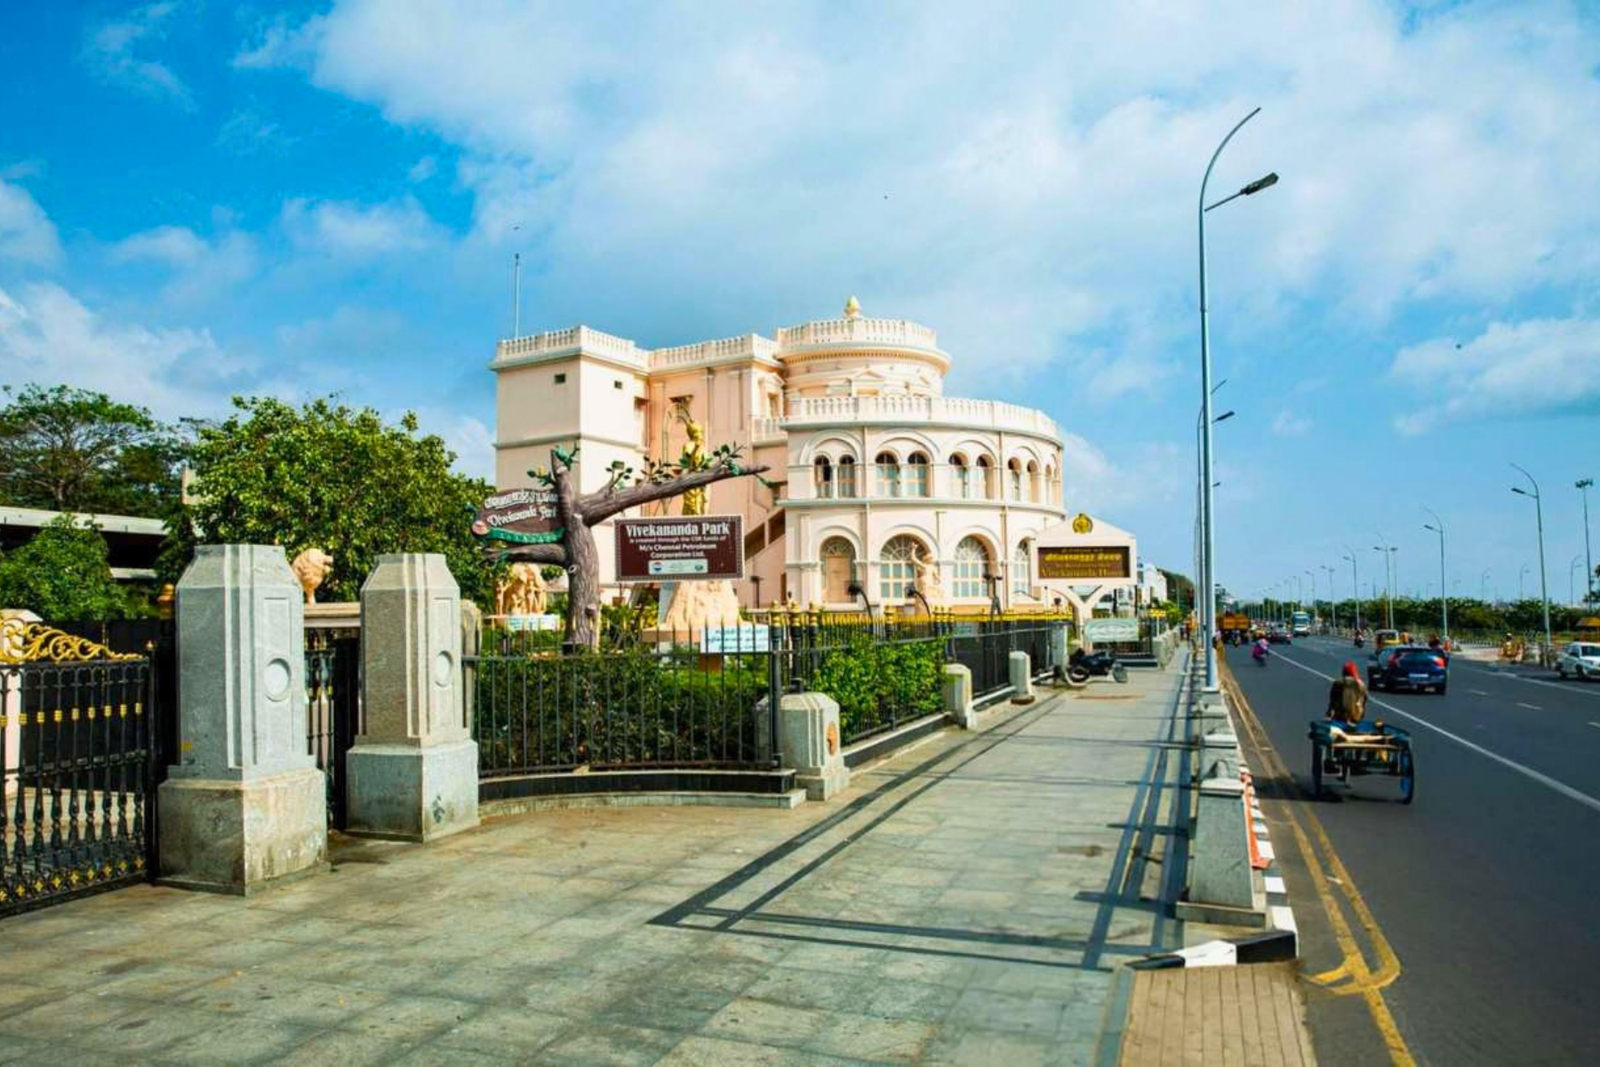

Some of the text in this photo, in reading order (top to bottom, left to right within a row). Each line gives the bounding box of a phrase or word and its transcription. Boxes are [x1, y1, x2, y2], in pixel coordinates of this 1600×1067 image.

[625, 521, 730, 537] Vivekananda Park
[653, 543, 681, 551] Chennai
[682, 542, 717, 550] Petroleum
[650, 551, 692, 560] Corporation
